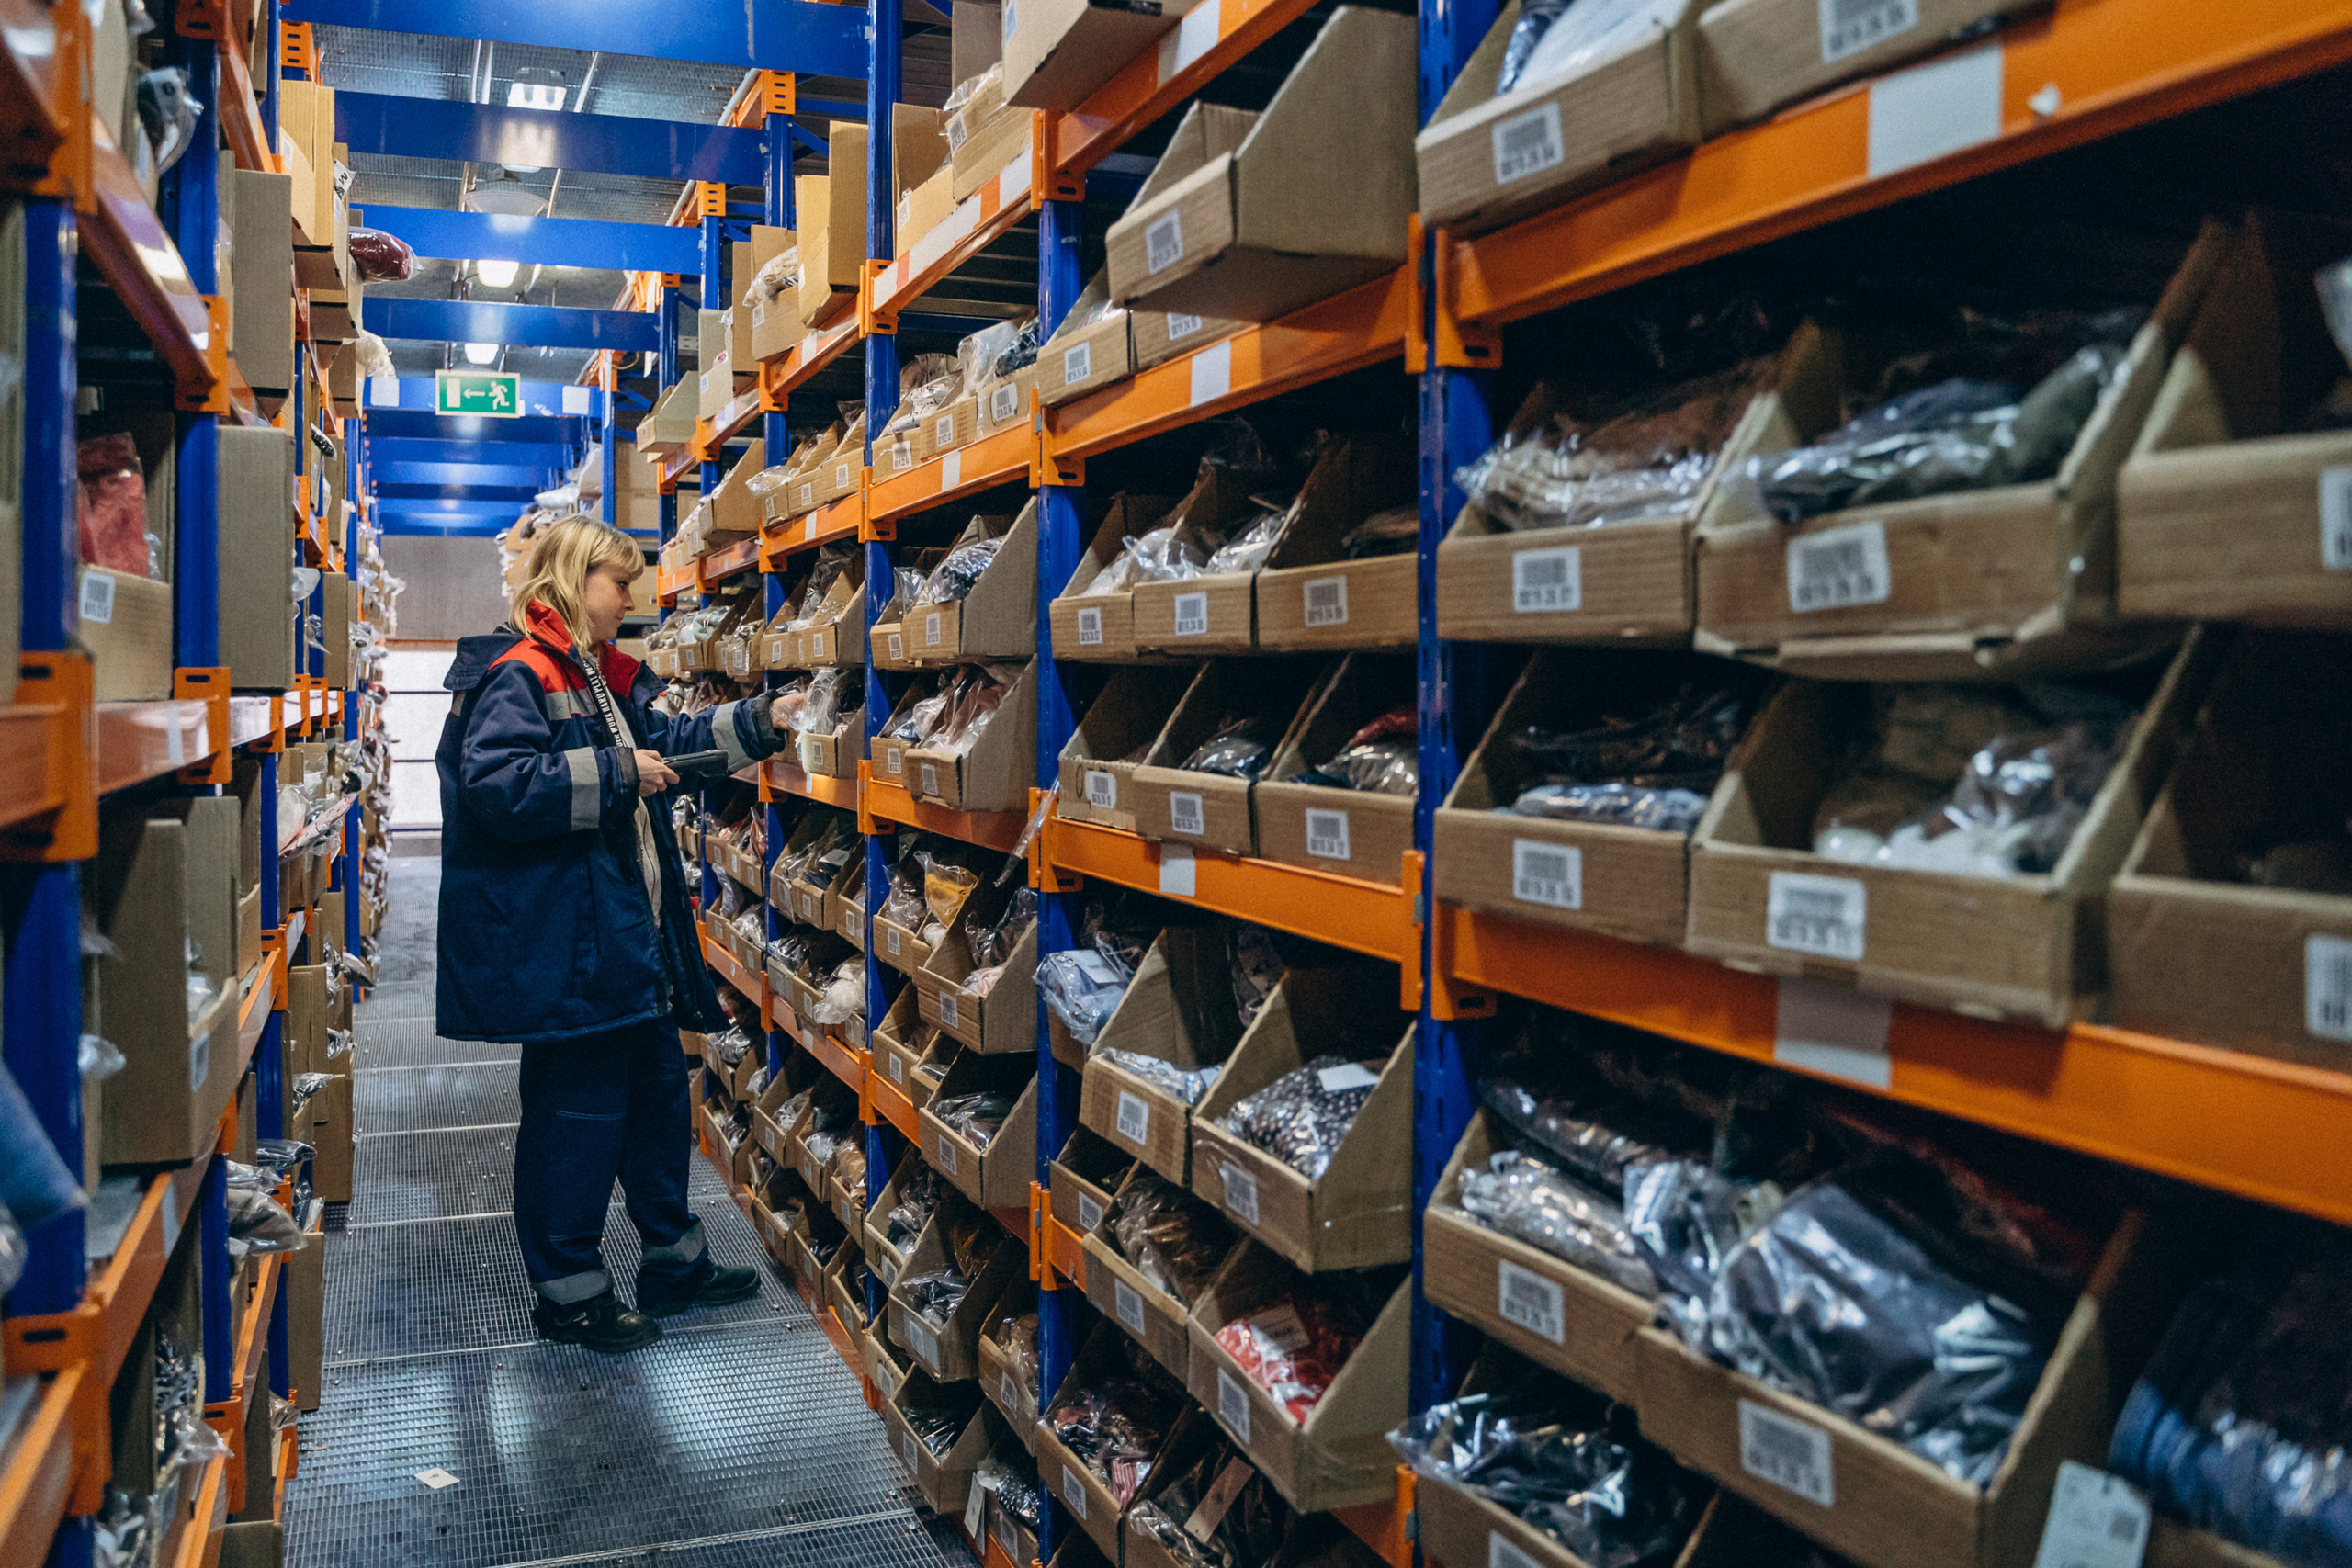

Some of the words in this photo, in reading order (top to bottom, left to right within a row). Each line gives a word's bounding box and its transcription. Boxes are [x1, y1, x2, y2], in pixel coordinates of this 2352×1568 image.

[589, 675, 603, 694] PLAY
[595, 693, 611, 713] HARD
[605, 712, 618, 734] WORK
